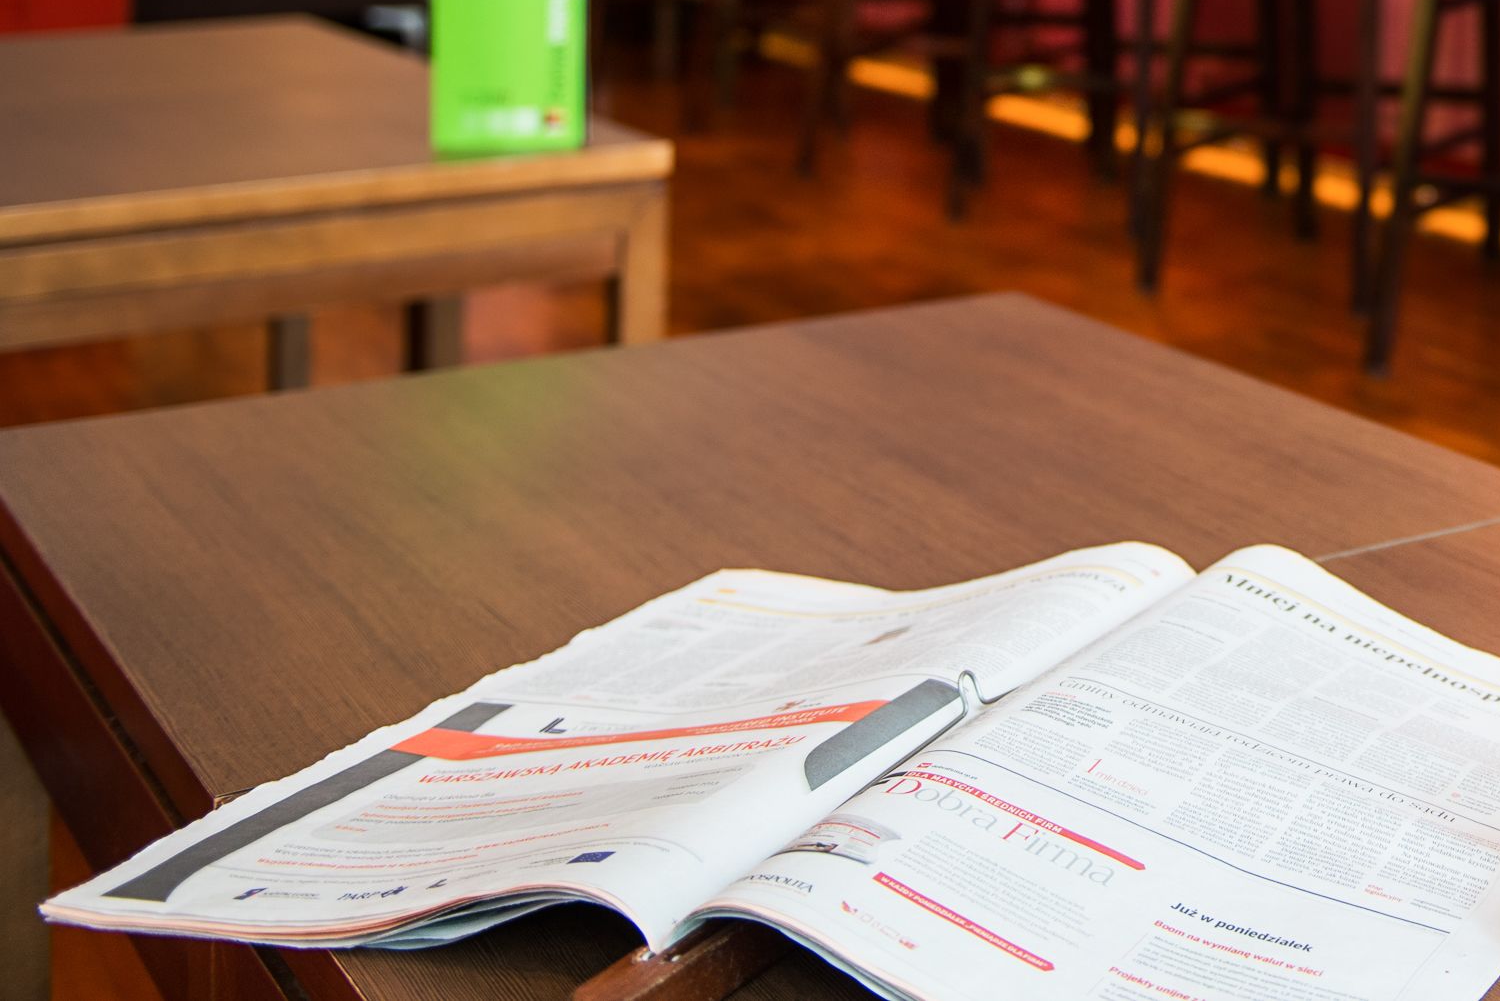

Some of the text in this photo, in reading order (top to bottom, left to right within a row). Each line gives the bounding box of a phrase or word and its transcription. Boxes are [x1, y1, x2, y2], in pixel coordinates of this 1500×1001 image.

[1304, 613, 1336, 632] na
[774, 706, 849, 721] INSTITUTE
[418, 764, 563, 784] WARSZAWSKĄ
[564, 749, 678, 771] AKADEMIĘ
[680, 735, 807, 759] ARBITRAŻU
[908, 771, 929, 779] DLA
[931, 775, 974, 792] MAŁYCH
[980, 793, 1034, 821] ŚREDNICH
[1034, 816, 1063, 834] FIRM
[1314, 768, 1374, 794] prawa
[1380, 792, 1404, 804] do
[885, 777, 998, 831] Dobra
[1002, 821, 1116, 887] Firma
[1153, 919, 1324, 978] Boom na wymianę walut w sieci
[1171, 902, 1314, 953] Już w poniedziałek
[1108, 966, 1155, 989] Projekty
[1155, 983, 1191, 1001] unijne
